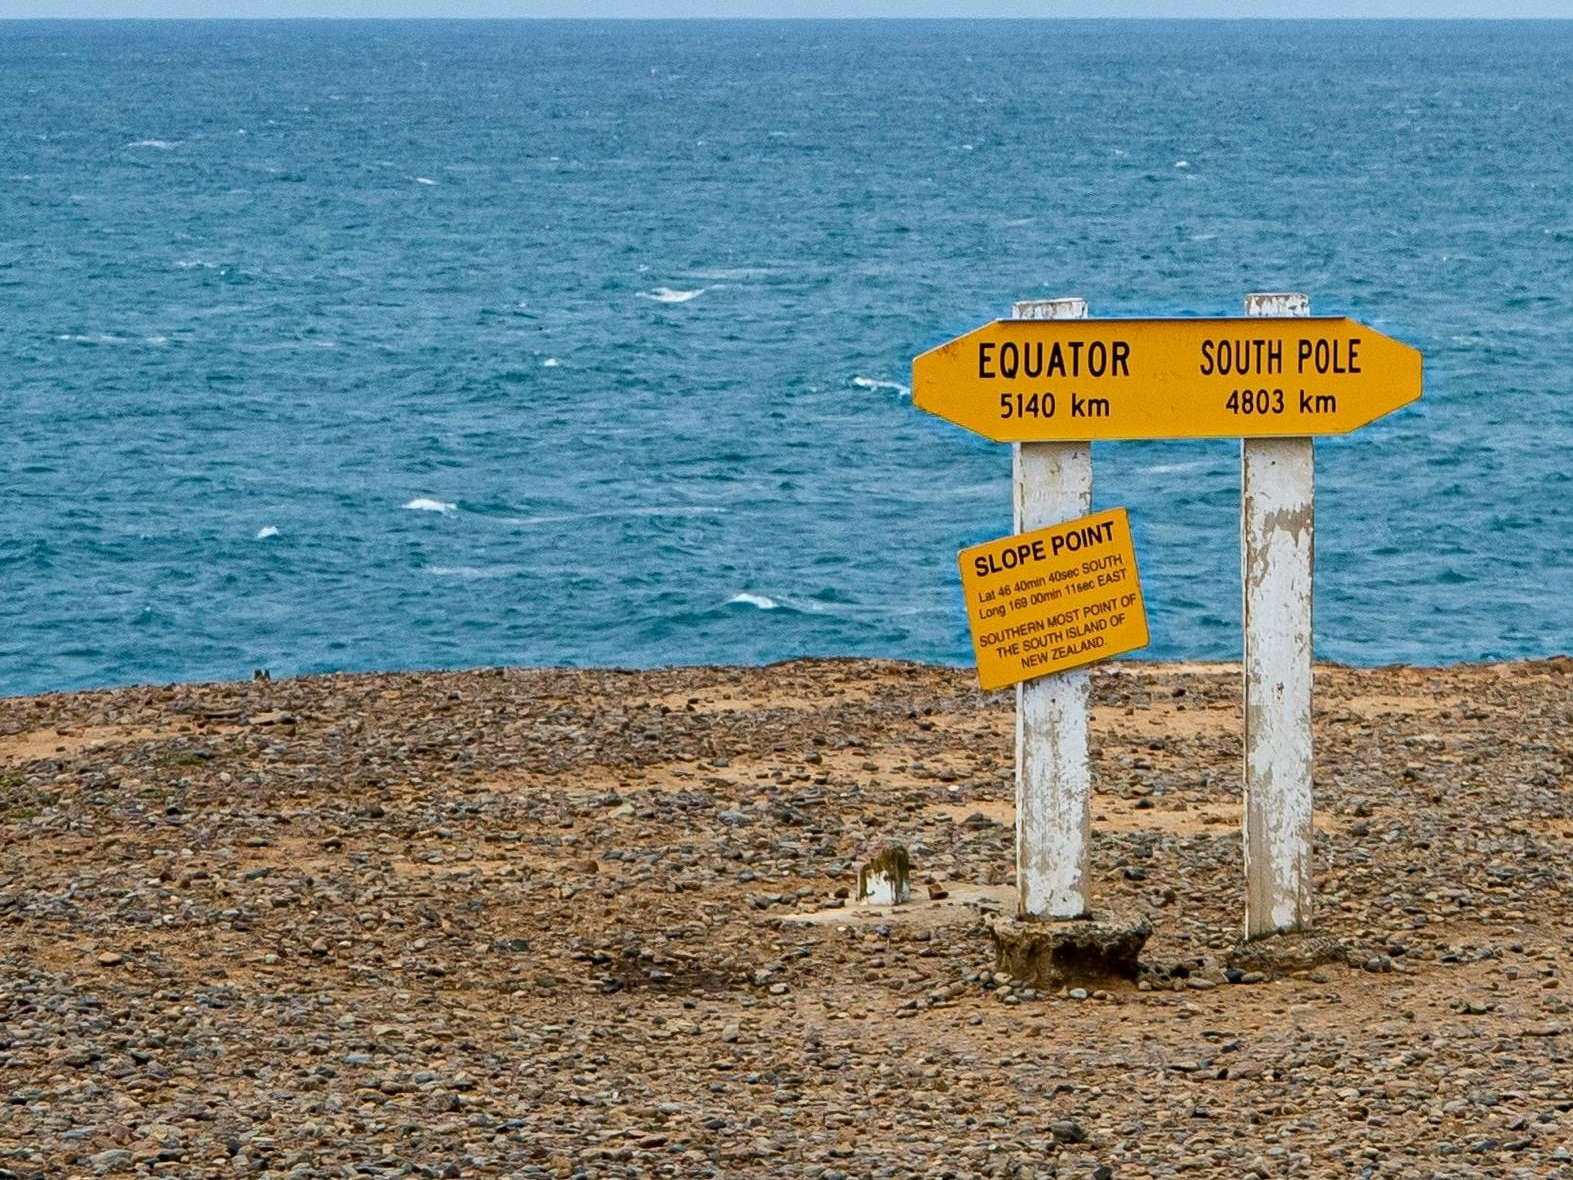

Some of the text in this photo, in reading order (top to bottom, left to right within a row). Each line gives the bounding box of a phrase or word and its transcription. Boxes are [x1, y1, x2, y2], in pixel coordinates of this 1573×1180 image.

[978, 341, 1130, 379] EQUATOR
[1200, 339, 1361, 376] SOUTH POLE
[1000, 392, 1110, 418] 5140 km
[1226, 389, 1337, 415] 4803 km
[975, 521, 1114, 577] SLOPE POINT
[979, 554, 1123, 603] Lat 46 40min 40sec SOUTH
[979, 569, 1127, 619] Long 169 00min 11sec EAST
[980, 593, 1136, 648] SOUTHERN MOST POINT OF
[997, 613, 1126, 659] THE SOUTH ISLAND OF
[1021, 652, 1048, 669] NEW
